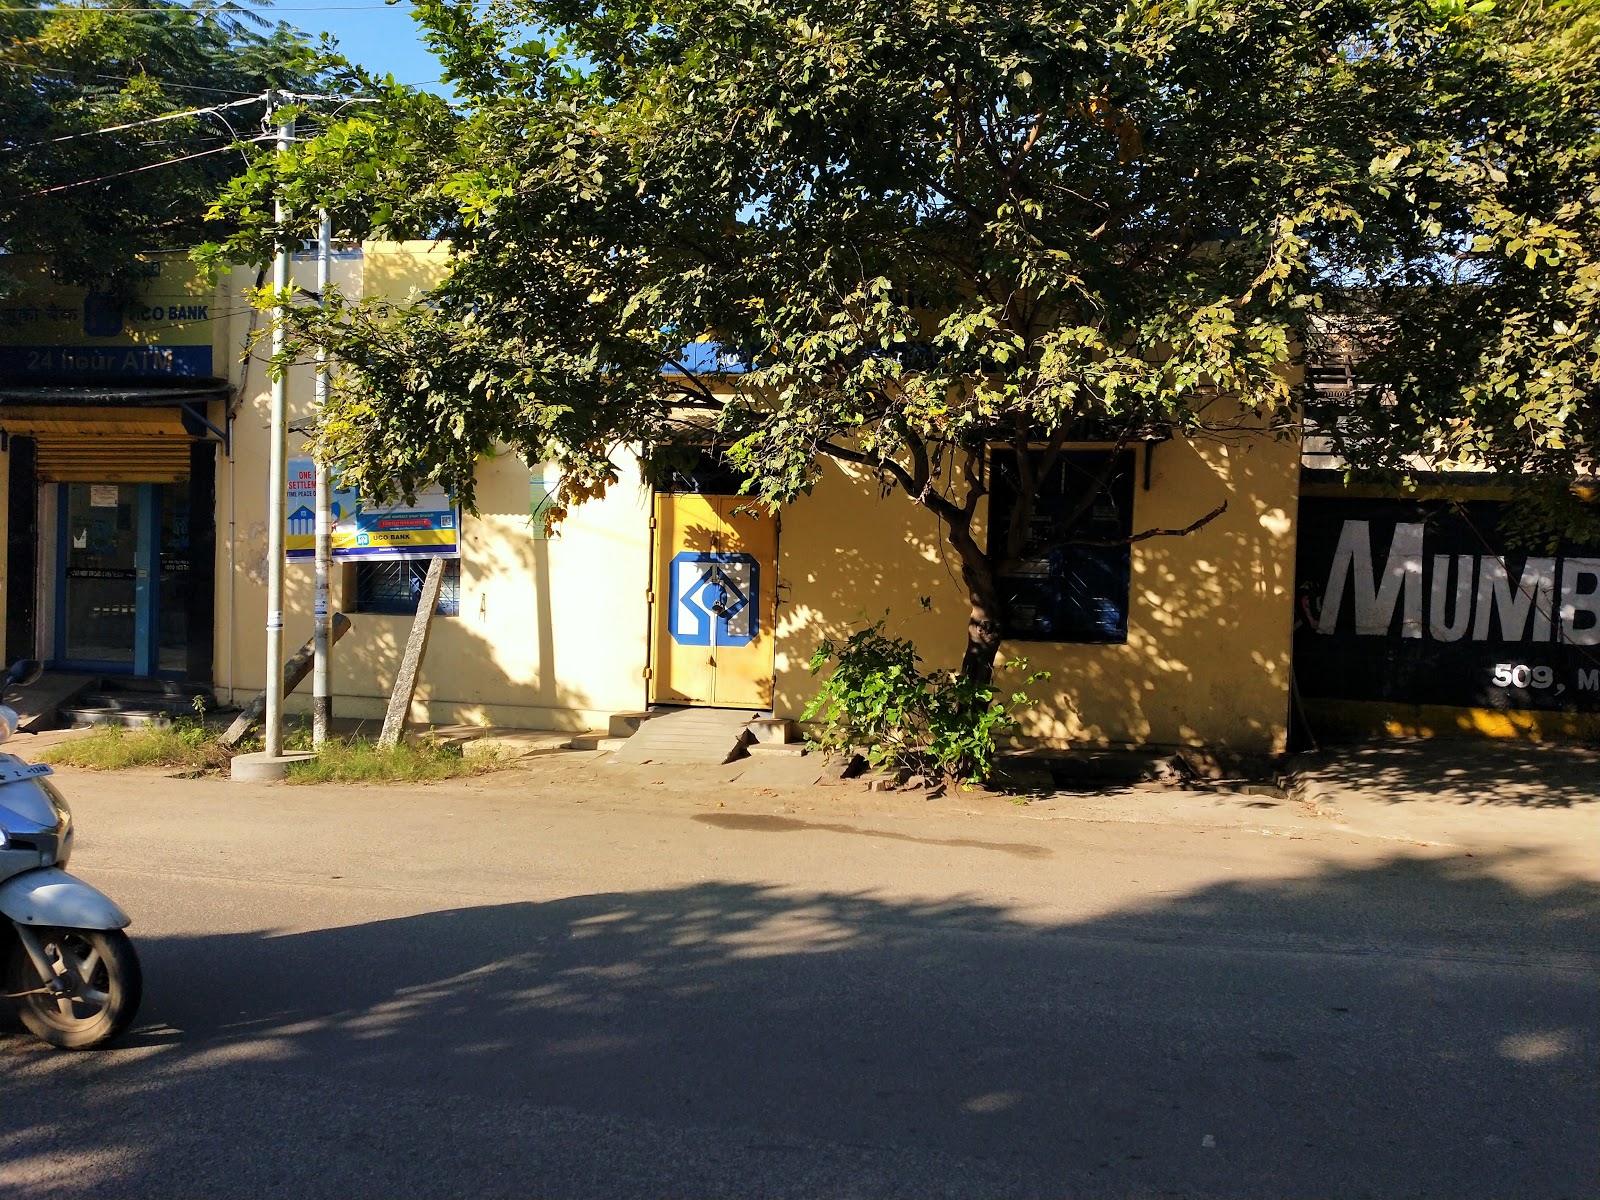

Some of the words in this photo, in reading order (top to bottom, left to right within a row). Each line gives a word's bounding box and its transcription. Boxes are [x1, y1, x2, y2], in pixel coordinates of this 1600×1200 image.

[168, 306, 209, 320] BANK
[28, 351, 53, 370] 24
[61, 351, 114, 370] hour
[120, 350, 174, 370] ATM
[299, 471, 312, 480] ONE
[288, 480, 317, 490] SETTLEM
[1492, 662, 1566, 695] 509,
